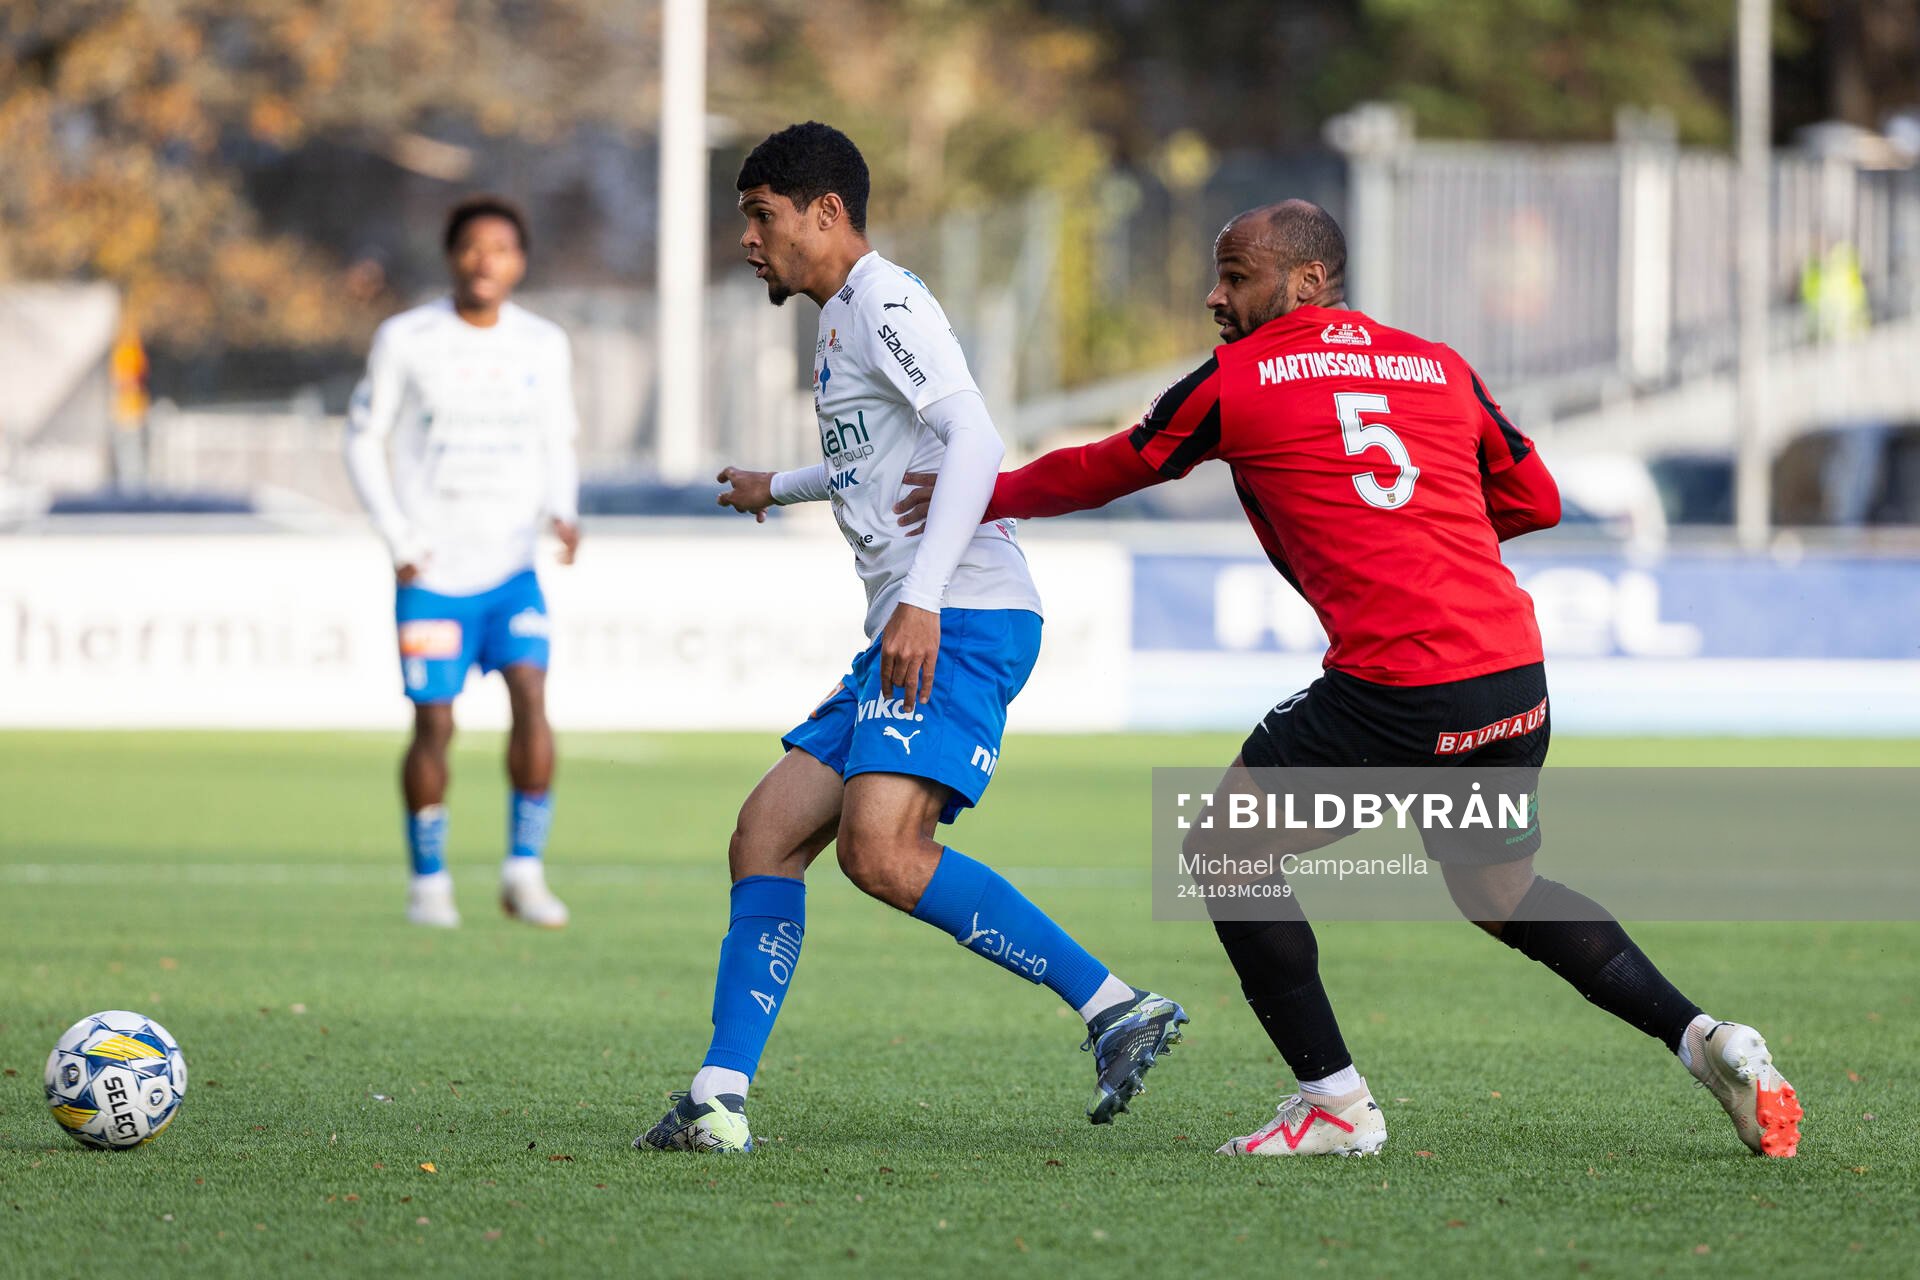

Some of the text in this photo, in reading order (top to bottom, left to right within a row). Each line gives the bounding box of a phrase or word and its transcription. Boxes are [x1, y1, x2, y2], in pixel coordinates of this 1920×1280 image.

[877, 324, 927, 387] stadium
[1257, 351, 1448, 386] MARTINSSON NGOUALI
[832, 443, 875, 472] group
[1333, 392, 1420, 510] 5
[1437, 700, 1547, 754] BAUHAUS
[749, 988, 777, 1016] 4
[103, 1076, 140, 1140] SELECT
